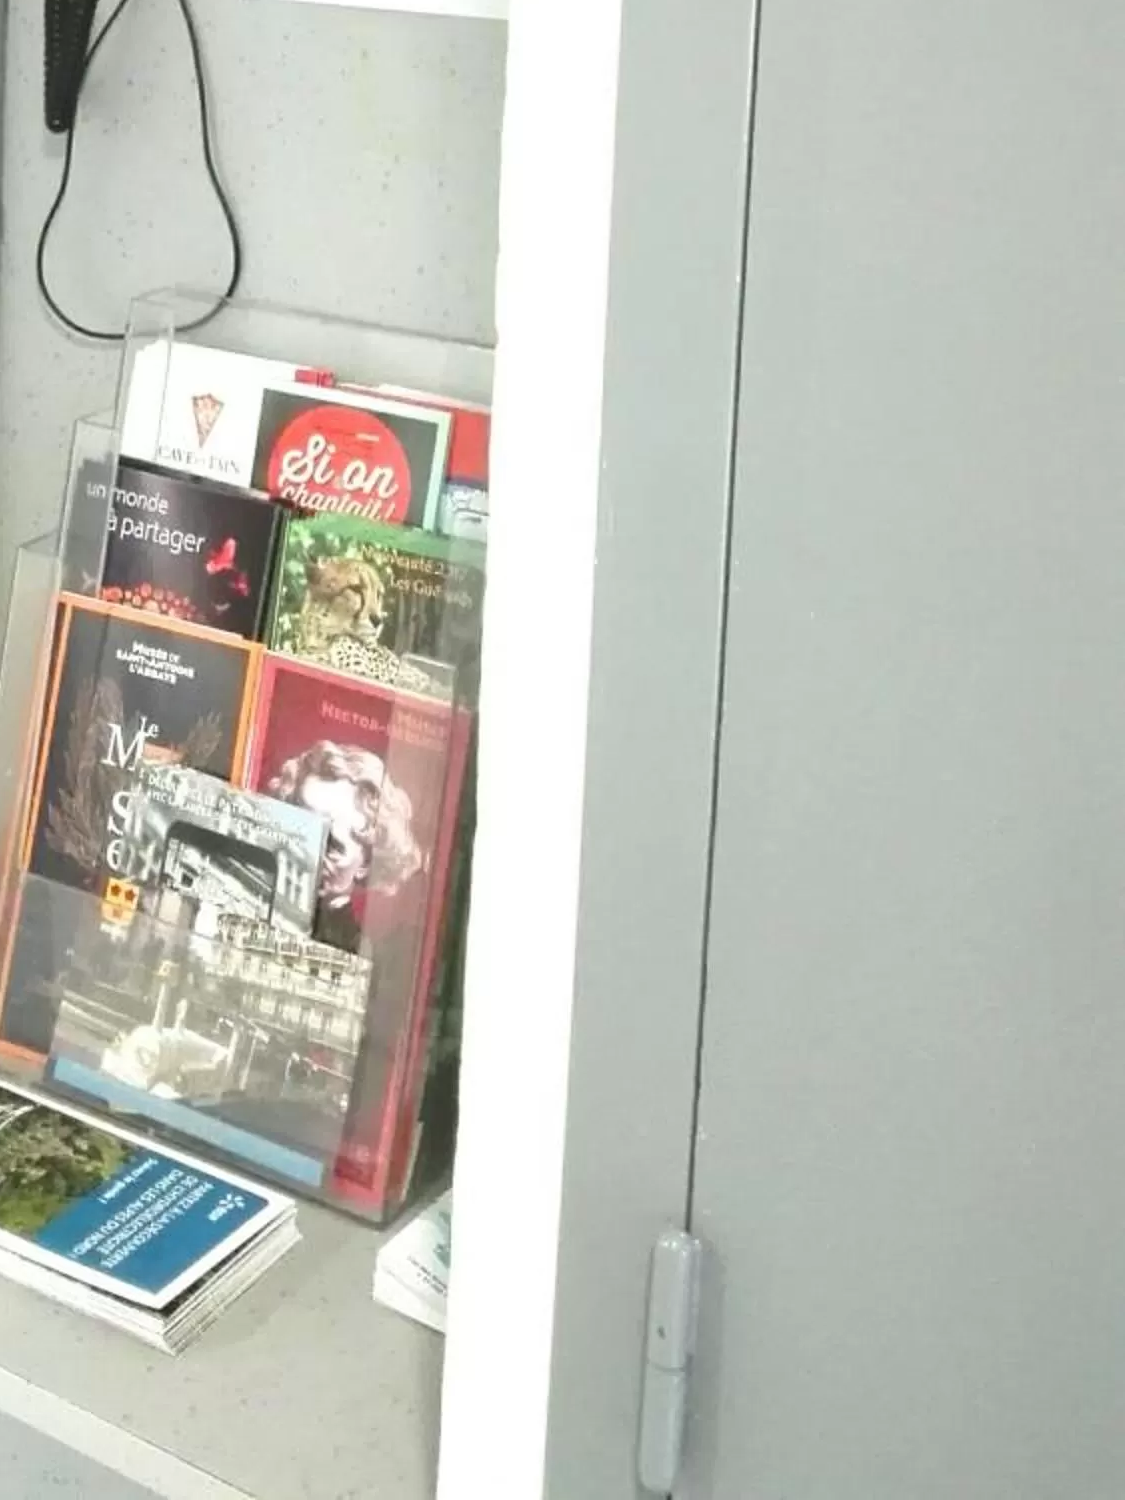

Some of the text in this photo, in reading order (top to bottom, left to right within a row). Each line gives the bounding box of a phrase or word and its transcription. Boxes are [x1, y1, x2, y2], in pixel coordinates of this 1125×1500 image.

[278, 433, 400, 498] Si on
[86, 481, 169, 515] un monde
[119, 516, 206, 555] partager
